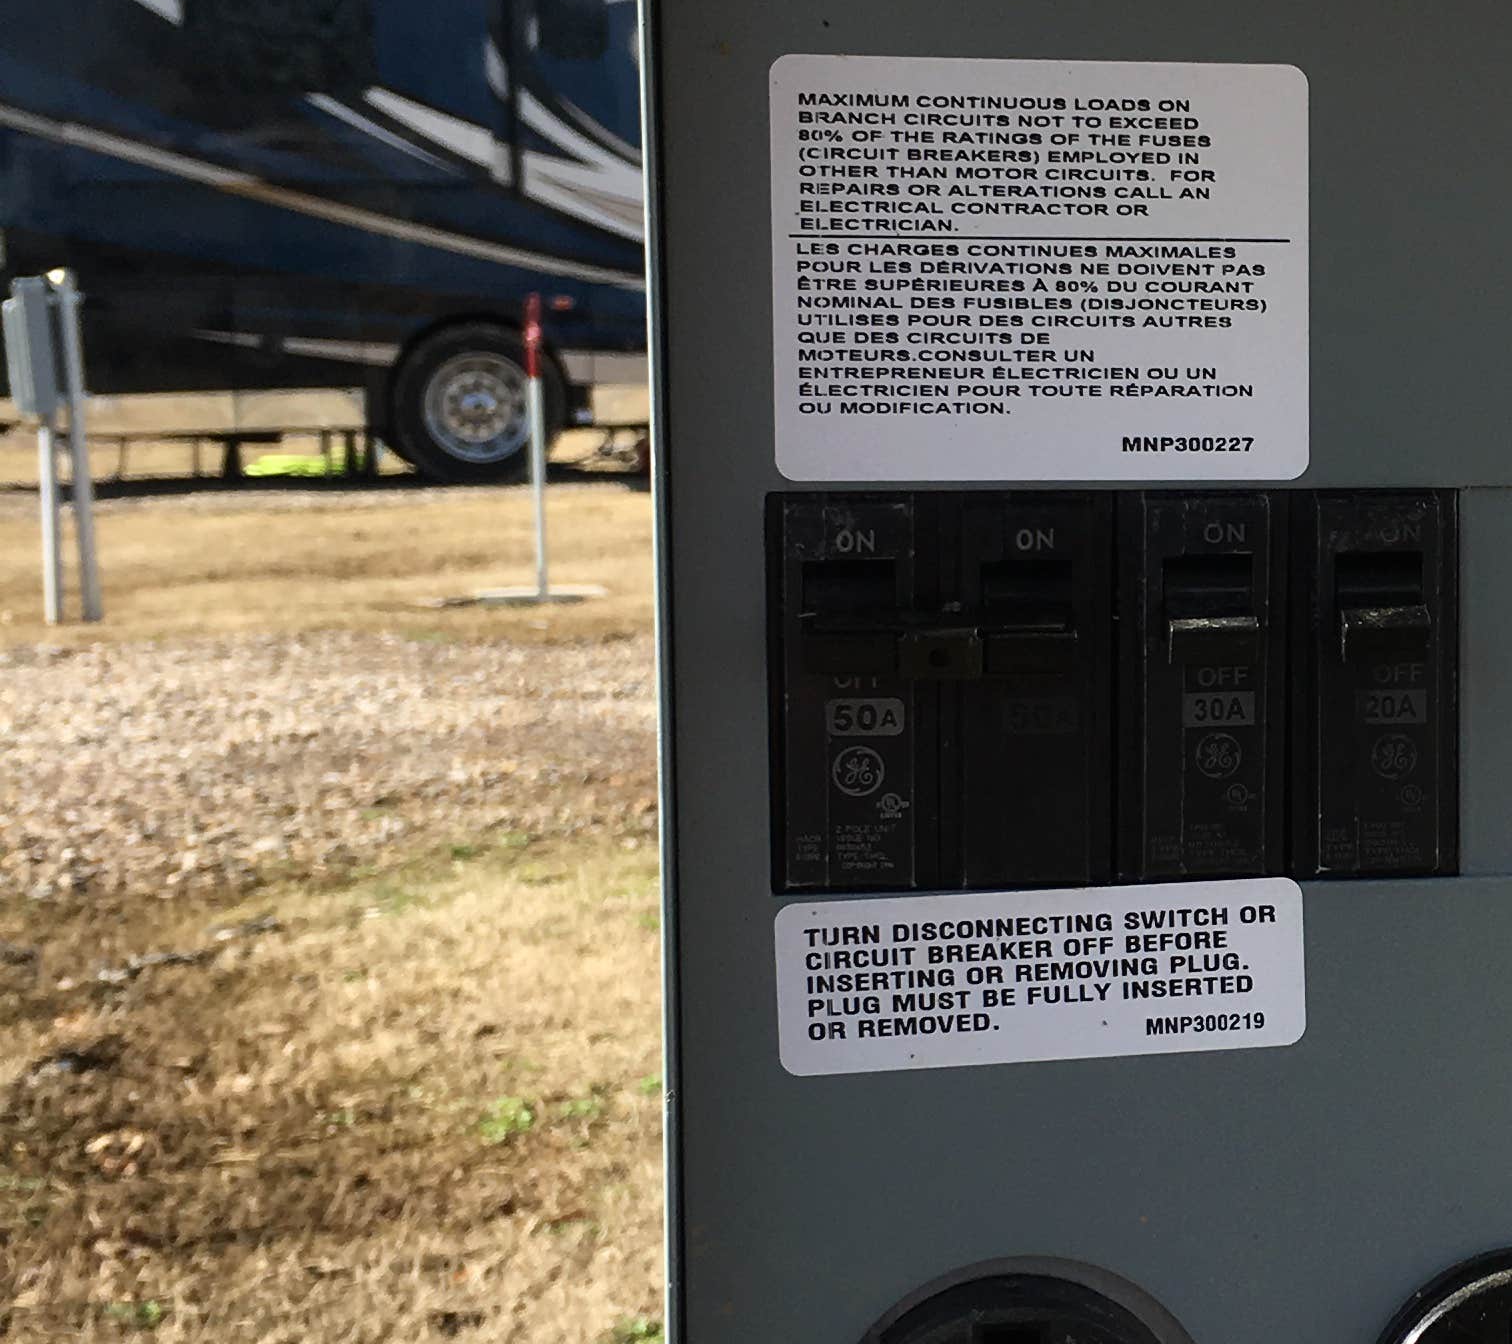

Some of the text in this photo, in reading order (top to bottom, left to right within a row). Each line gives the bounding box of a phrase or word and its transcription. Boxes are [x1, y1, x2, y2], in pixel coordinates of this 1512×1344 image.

[799, 93, 1189, 112] MAXIMUM CONTINUOUS LOADS ON
[799, 111, 1198, 129] BRANCH CIRCUITS NOT TO EXCEED
[799, 130, 1211, 147] 80% OF THE RATINGS OF THE FUSES
[799, 148, 1198, 164] (CIRCUIT BREAKERS) EMPLOYED IN
[799, 165, 1215, 182] OTHER THAN MOTOR CIRCUITS. FOR
[800, 183, 1209, 199] REPAIRS OR ALTERATIONS CALL AN
[801, 200, 1148, 216] ELECTRICAL CONTRACTOR OR
[801, 218, 958, 231] ELECTRICIAN.
[797, 243, 1235, 258] LES CHARGES CONTINUES MAXIMALES
[797, 260, 1265, 276] POUR LES DÉRIVATIONS NE DOIVENT PAS
[798, 276, 1254, 293] ÊTRE SUPÉRIEURES À 80% DU COURANT
[798, 296, 1266, 313] NOMINAL DES FUSIBLES (DISJONCTEURS)
[798, 314, 1231, 328] UTILISES POUR DES CIRCUITS AUTRES
[798, 332, 1049, 344] QUE DES CIRCUITS DE
[1065, 350, 1094, 362] UN
[799, 366, 1216, 379] ENTREPRENEUR ÉLECTRICIEN OU UN
[799, 382, 1252, 397] ÉLECTRICIEN POUR TOUTE RÉPARATION
[799, 402, 1010, 414] OU MODIFICATION.
[1123, 437, 1254, 451] MNP300227
[836, 530, 875, 553] ON
[1017, 529, 1055, 551] ON
[1204, 523, 1246, 545] ON
[1198, 667, 1248, 686] OFF
[1374, 664, 1423, 683] OFF
[1193, 696, 1245, 721] 30A
[1364, 693, 1417, 718] 20A
[834, 705, 897, 731] 50A
[804, 905, 1275, 947] TURN DISCONNECTING SWITCH OR
[806, 931, 1227, 970] CIRCUIT BREAKER OFF BEFORE
[807, 953, 1248, 996] INSERTING OR REMOVING PLUG.
[809, 976, 1253, 1017] PLUG MUST BE FULLY INSERTED
[808, 1012, 1264, 1040] OR REMOVED. MNP300219
